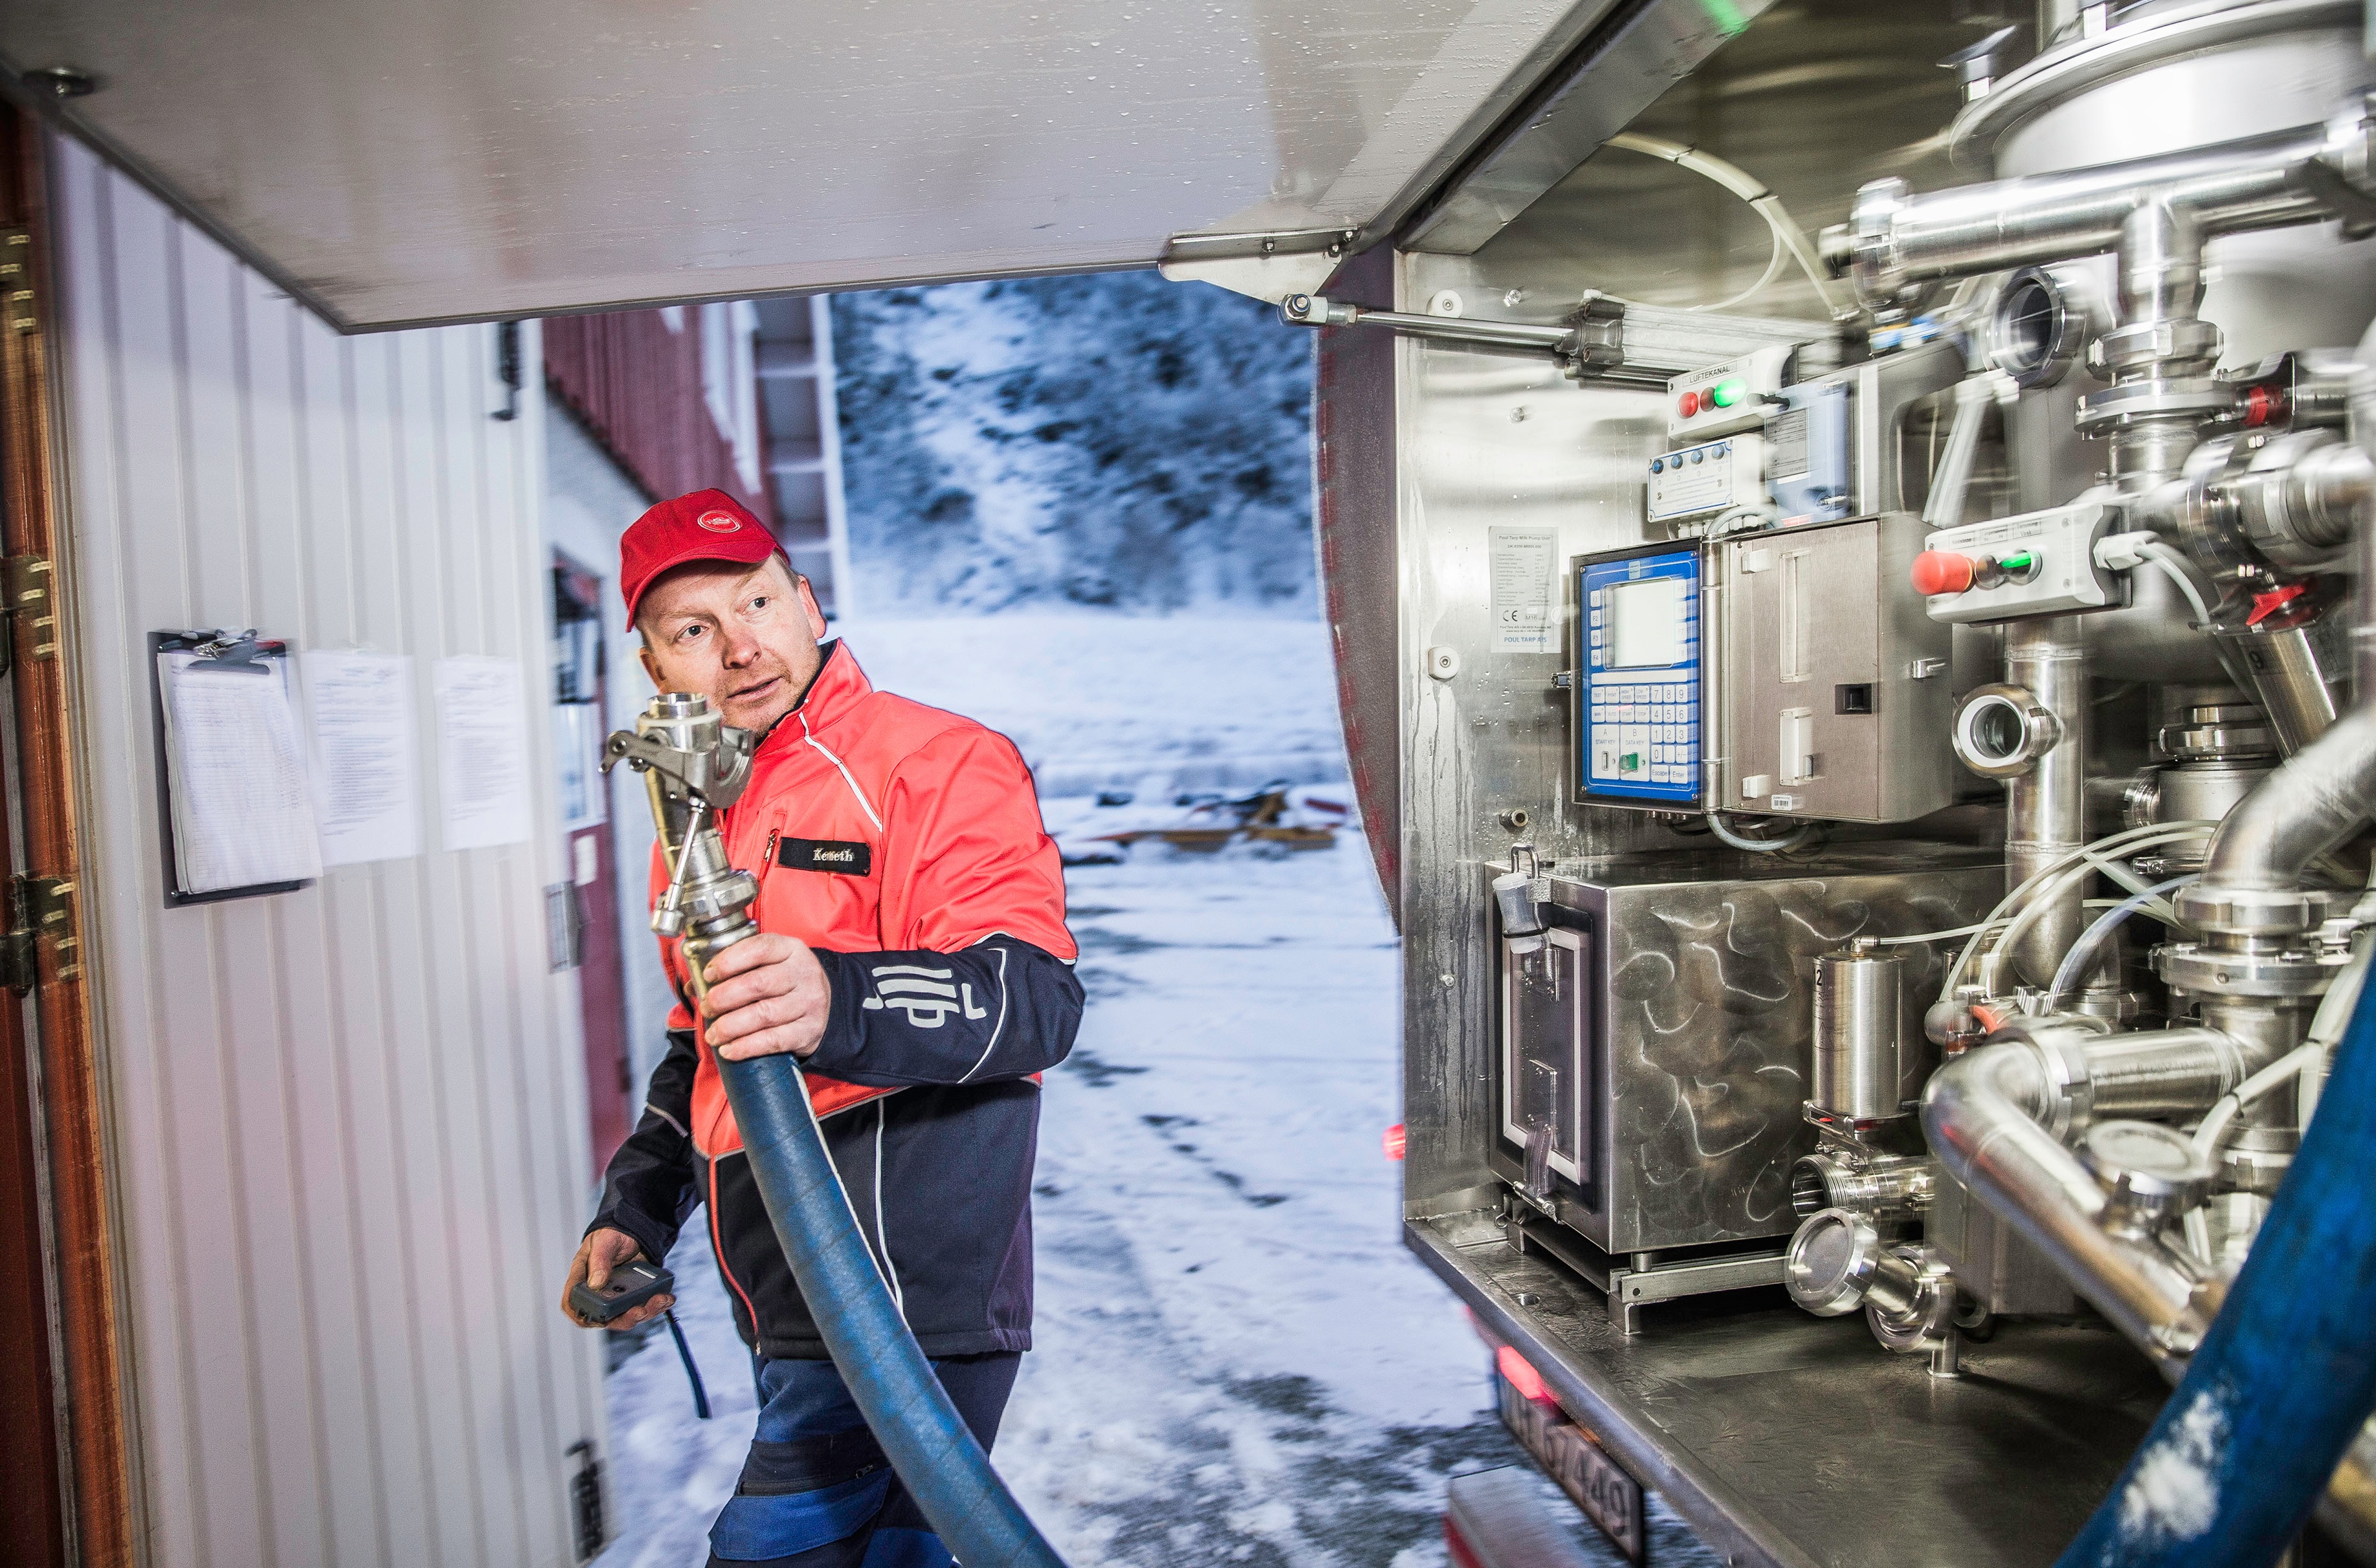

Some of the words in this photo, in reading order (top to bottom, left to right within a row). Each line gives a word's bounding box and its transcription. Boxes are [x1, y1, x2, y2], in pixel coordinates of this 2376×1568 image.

[1690, 366, 1730, 383] LUFTEKANAL
[1502, 610, 1518, 622] CE
[1655, 690, 1658, 699] 7
[1666, 690, 1671, 699] 8
[1679, 689, 1684, 699] 9
[1655, 710, 1658, 718] 4
[1666, 710, 1671, 719] 5
[1679, 710, 1684, 719] 6
[1666, 730, 1671, 739] 2
[1679, 730, 1684, 739] 3
[1655, 750, 1659, 759] 0
